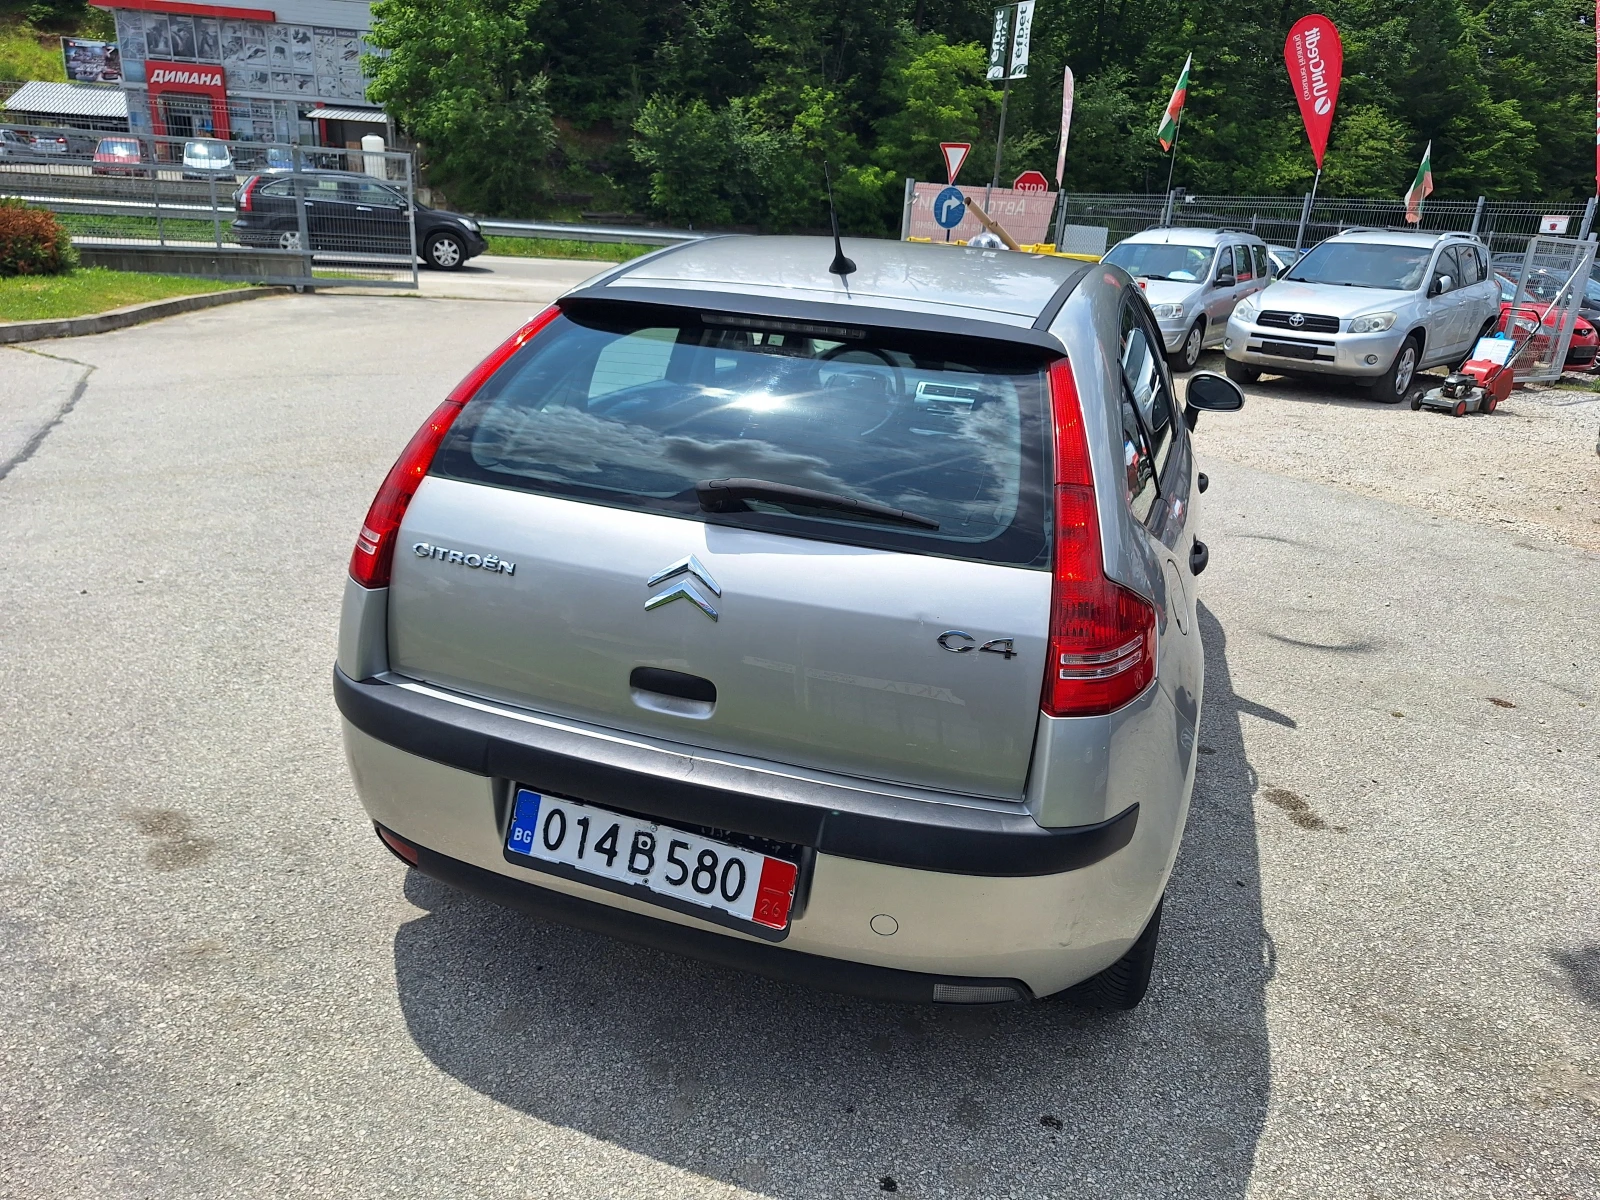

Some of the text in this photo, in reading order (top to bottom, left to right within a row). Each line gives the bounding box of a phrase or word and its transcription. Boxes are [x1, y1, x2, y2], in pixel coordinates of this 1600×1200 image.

[991, 10, 1004, 63] efbet
[1015, 6, 1027, 59] efbet
[150, 69, 222, 86] ДИМАНА
[412, 542, 516, 576] CITROËN
[937, 629, 1018, 660] C4
[513, 827, 532, 844] BG
